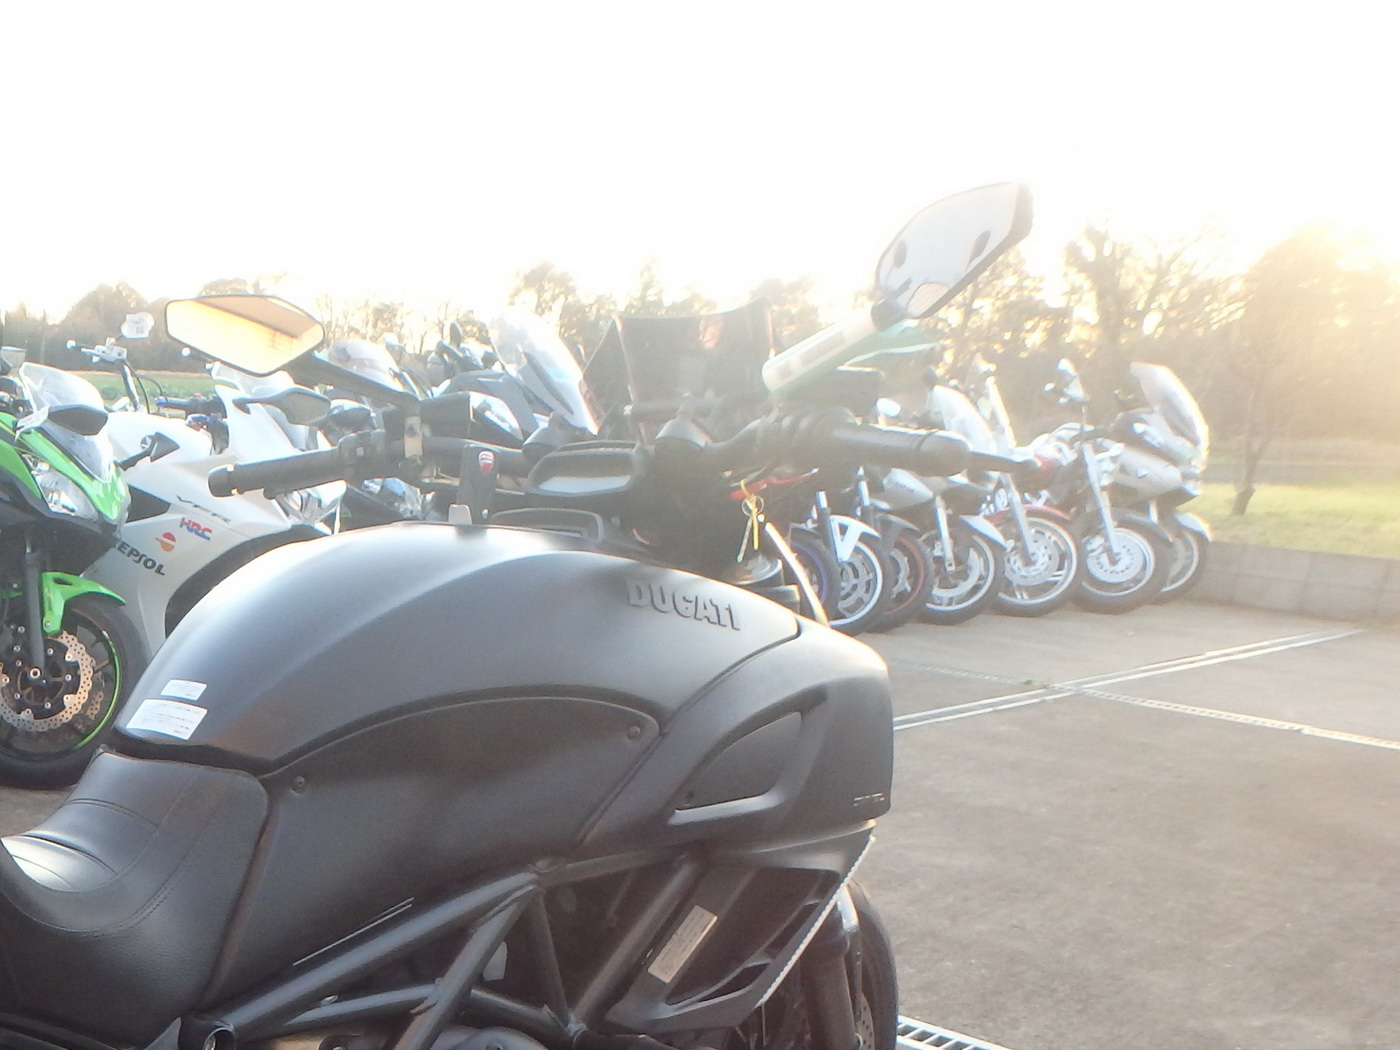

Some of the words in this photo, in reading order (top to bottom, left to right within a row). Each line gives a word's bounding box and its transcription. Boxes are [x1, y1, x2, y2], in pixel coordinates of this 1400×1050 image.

[179, 516, 213, 542] HRC
[115, 540, 166, 577] EPSOL
[627, 577, 741, 632] DUCATI
